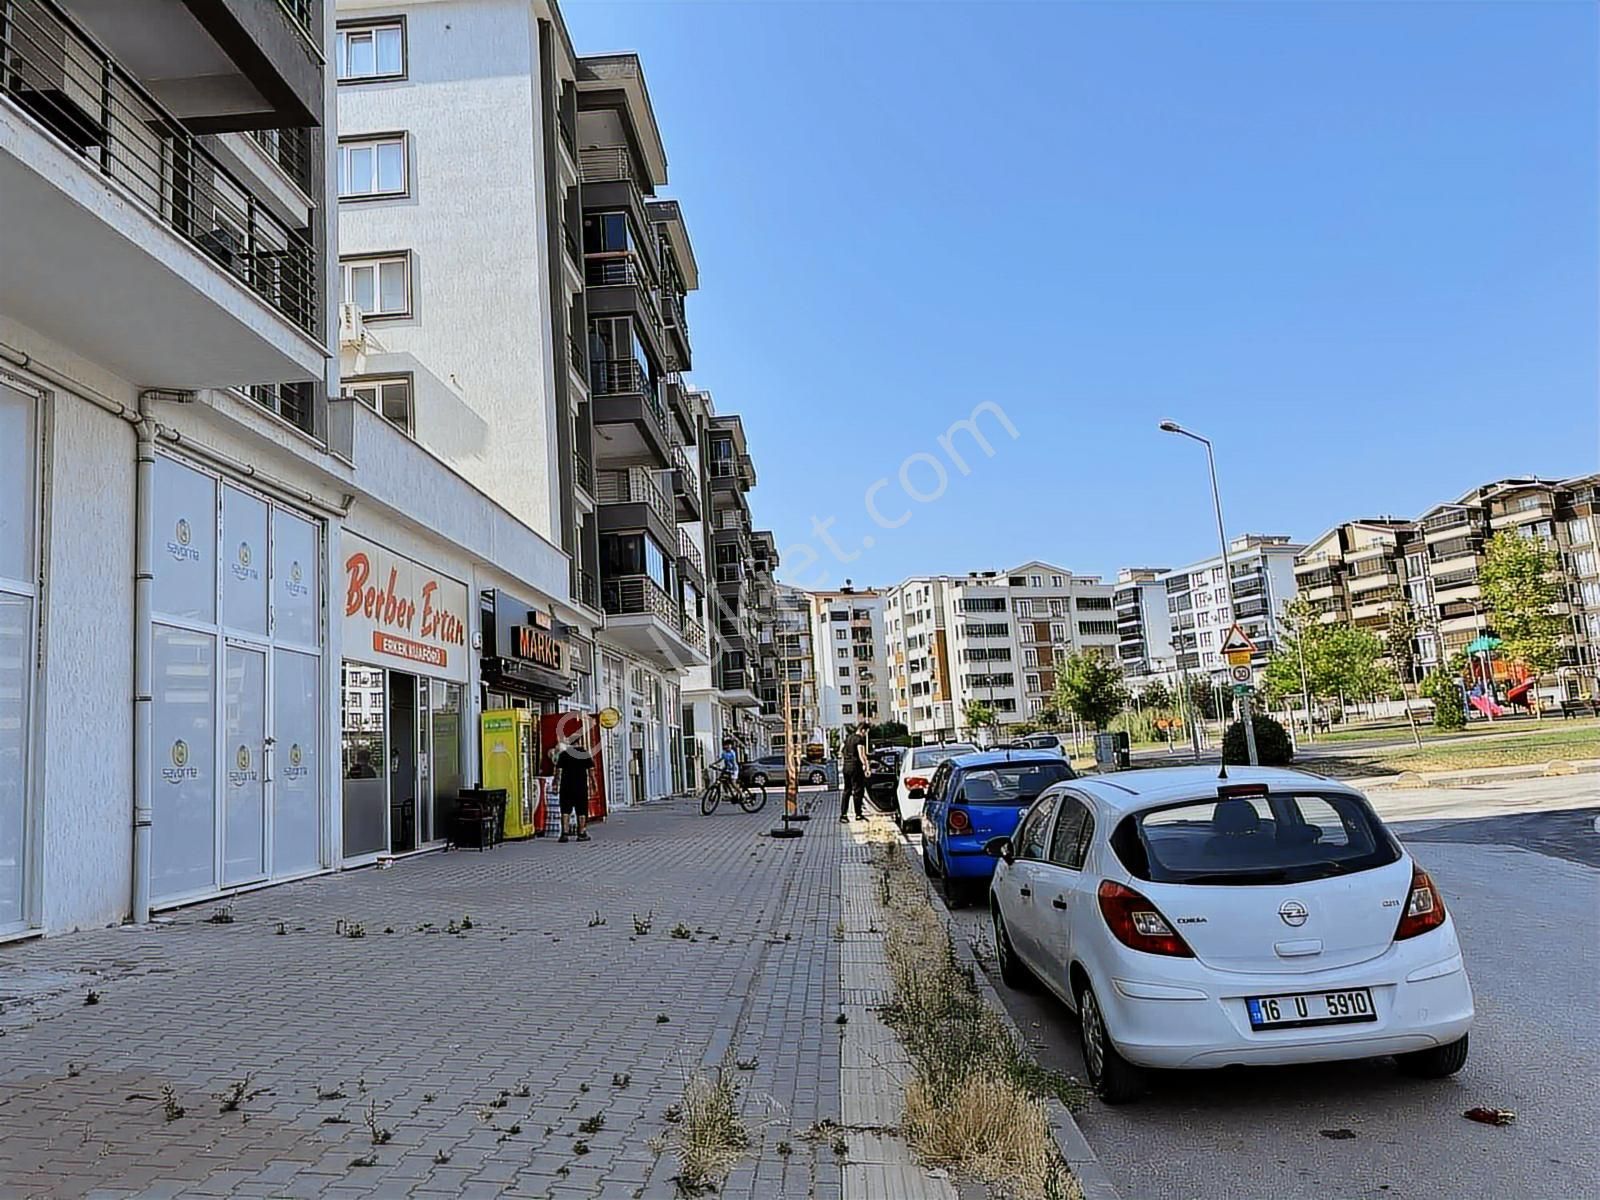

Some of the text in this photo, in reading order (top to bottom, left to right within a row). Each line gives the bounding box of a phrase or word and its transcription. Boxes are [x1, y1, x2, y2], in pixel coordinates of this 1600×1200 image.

[346, 552, 464, 646] Berber Ertan
[1261, 999, 1281, 1021] 16
[1294, 997, 1308, 1018] U
[1325, 993, 1368, 1016] 5910
